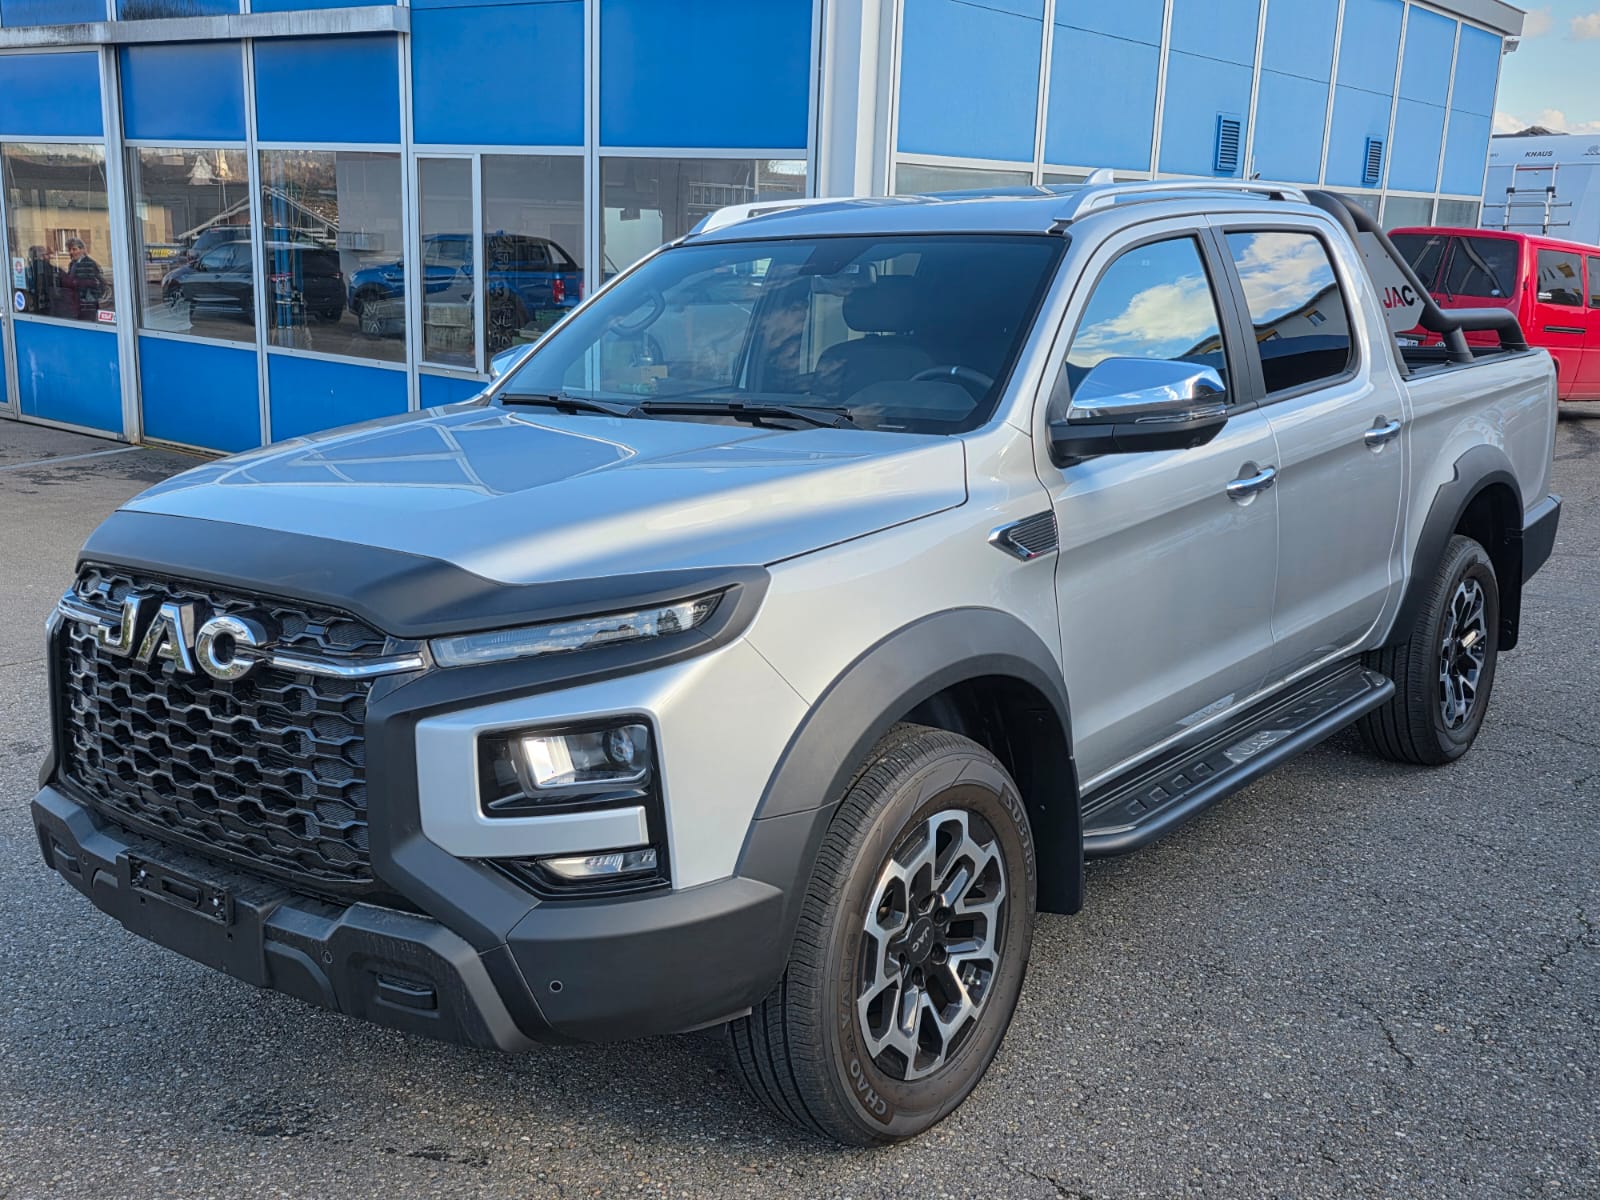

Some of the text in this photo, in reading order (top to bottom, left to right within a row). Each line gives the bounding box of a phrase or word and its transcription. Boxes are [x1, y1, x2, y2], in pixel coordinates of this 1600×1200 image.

[1525, 150, 1553, 158] KNAUS
[1383, 285, 1415, 309] JAC
[687, 604, 709, 615] JAC
[97, 593, 262, 681] JAC
[1238, 731, 1278, 756] JAC
[911, 926, 930, 953] JAC
